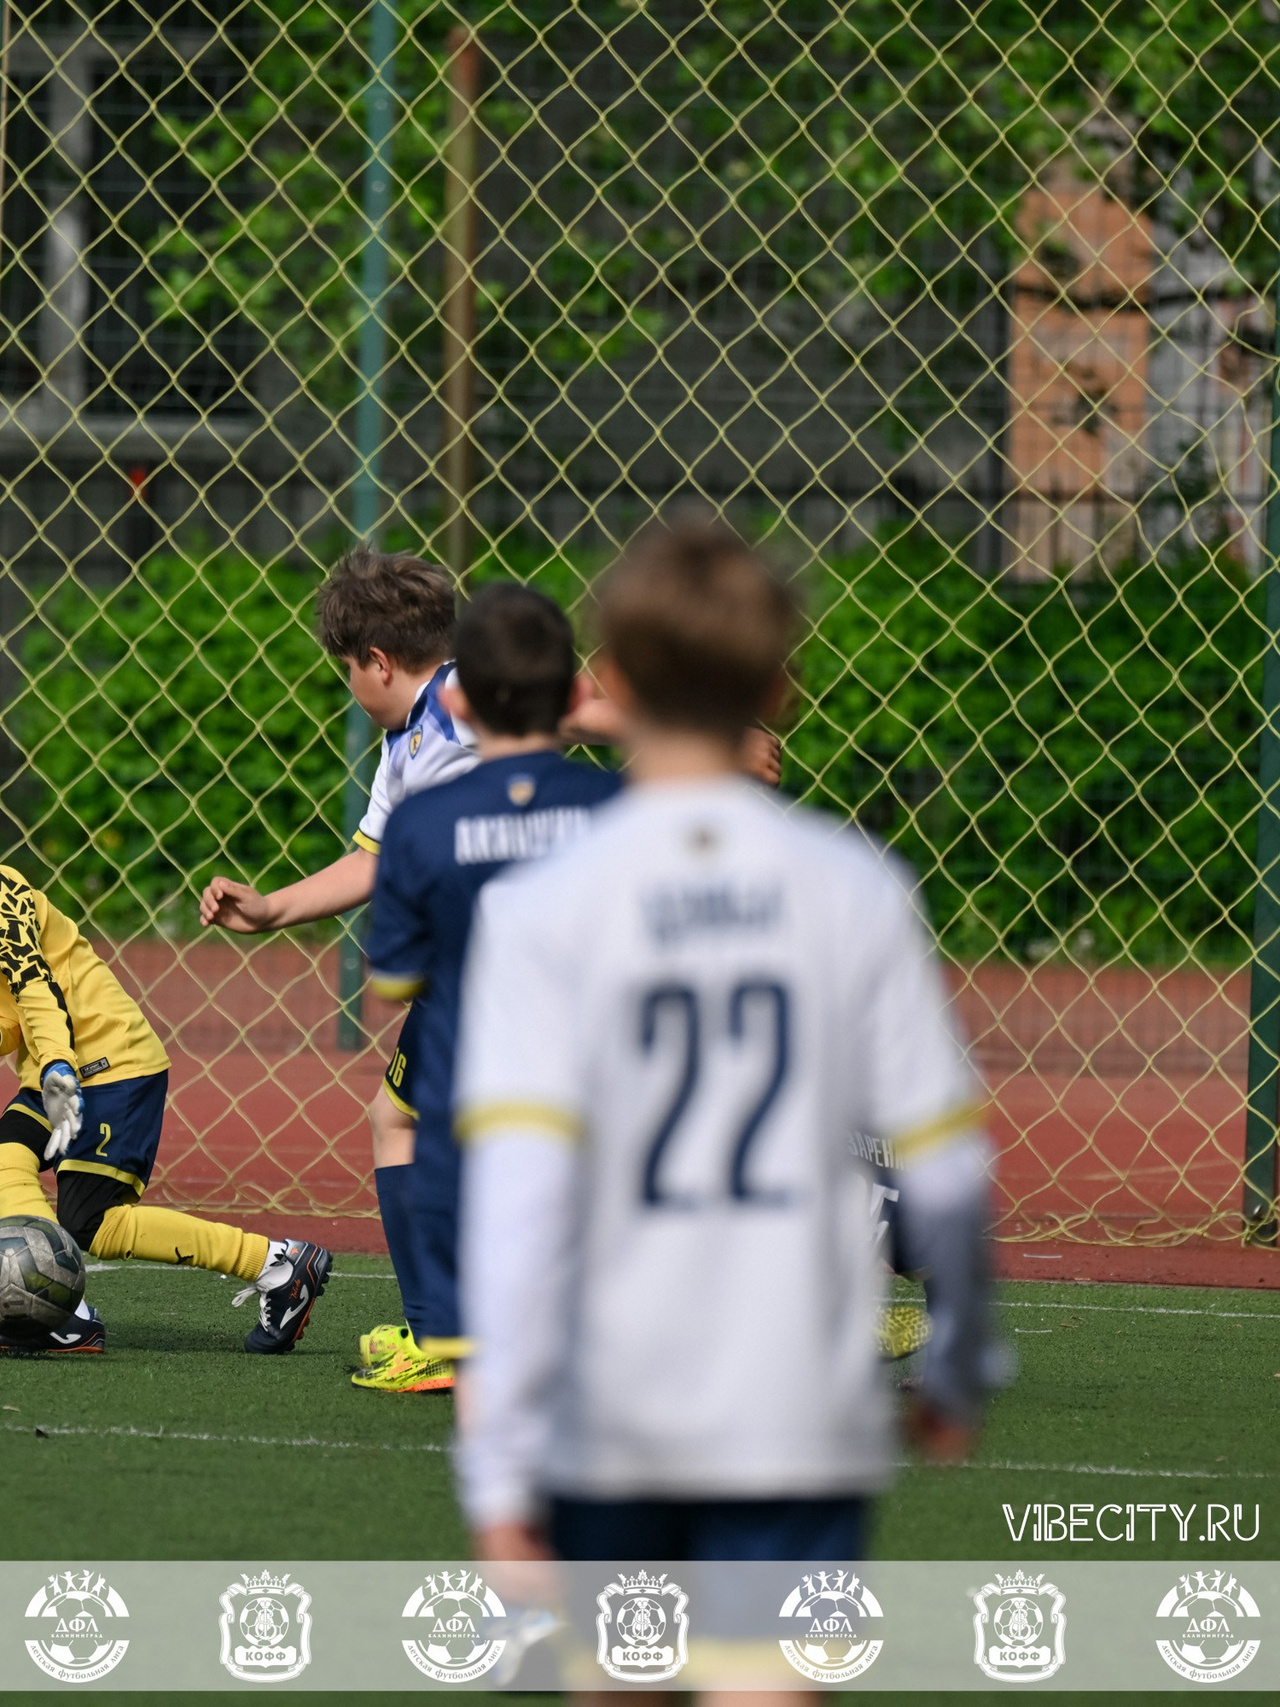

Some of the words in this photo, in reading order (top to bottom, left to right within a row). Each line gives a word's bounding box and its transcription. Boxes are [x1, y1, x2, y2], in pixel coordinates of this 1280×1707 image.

[388, 1047, 407, 1088] 16
[637, 974, 797, 1208] 22
[95, 1122, 112, 1157] 2
